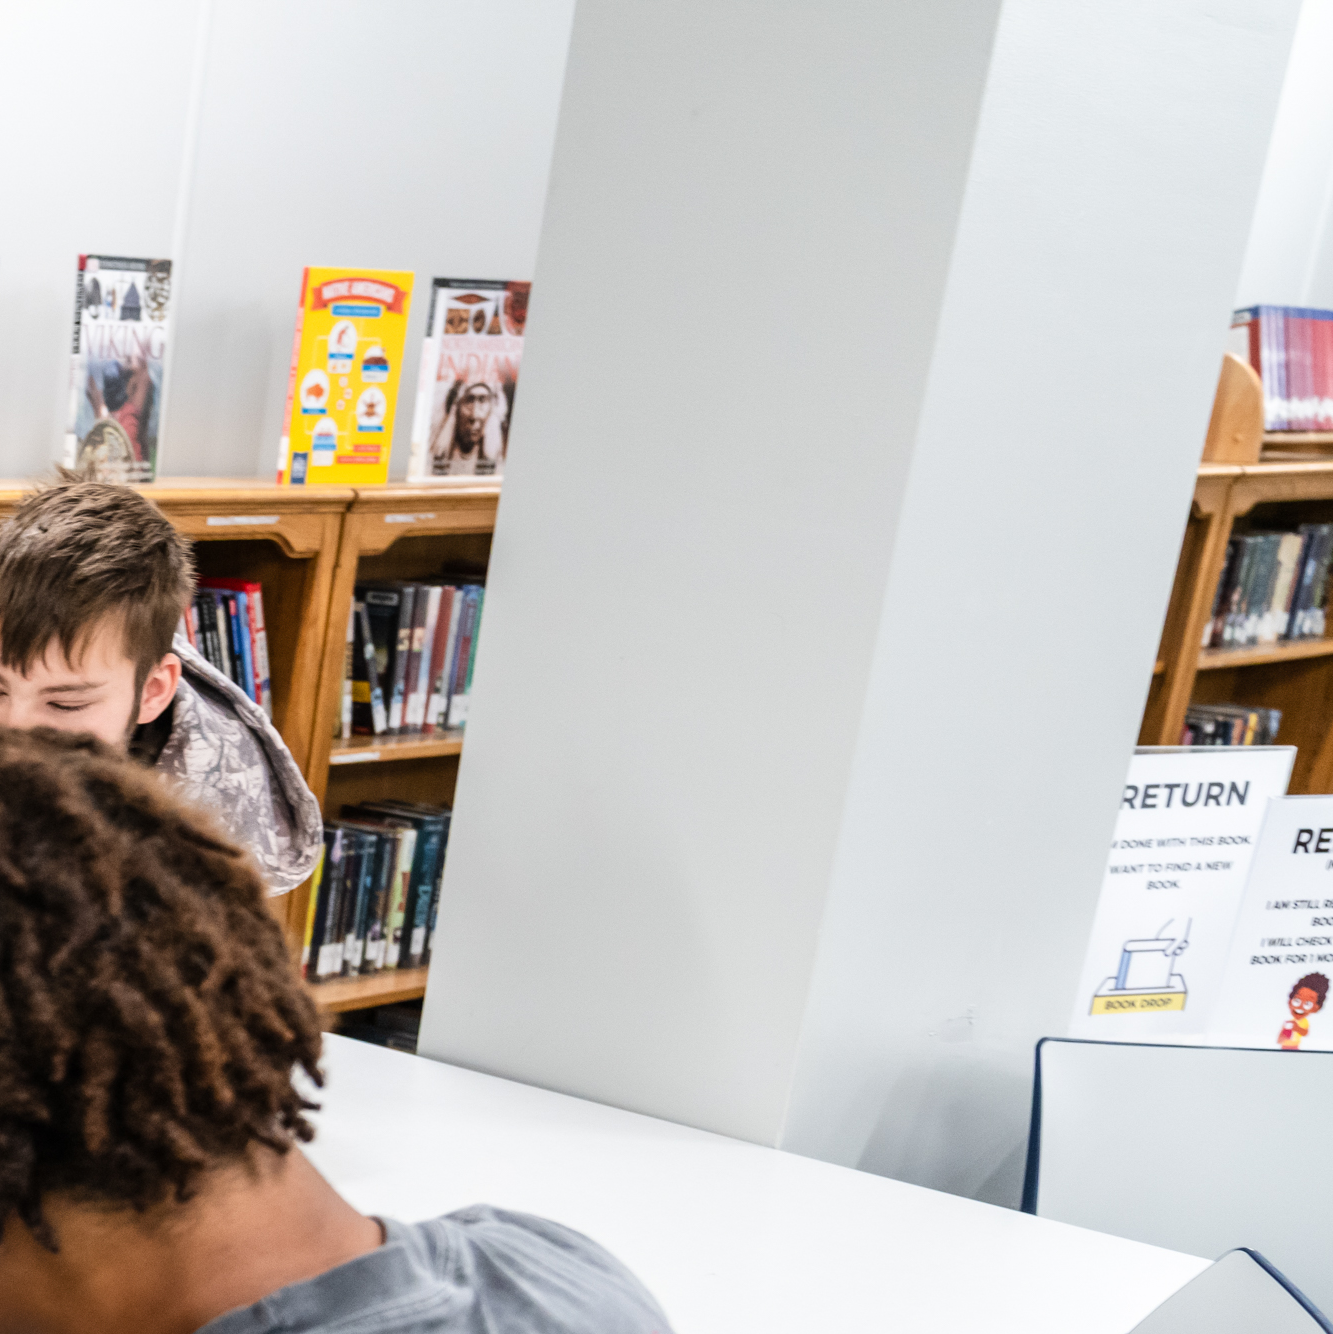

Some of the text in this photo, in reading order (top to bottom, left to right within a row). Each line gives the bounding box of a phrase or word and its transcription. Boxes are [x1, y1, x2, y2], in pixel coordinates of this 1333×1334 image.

[83, 324, 166, 361] VIKING
[1121, 781, 1250, 809] RETURN
[1120, 836, 1252, 849] DONE WITH THIS BOOK.
[1109, 864, 1144, 875] WANT
[1147, 864, 1163, 873] TO
[1166, 862, 1192, 873] FIND
[1205, 861, 1234, 872] NEW
[1146, 880, 1180, 890] BOOK.
[1292, 900, 1321, 910] STILL
[1267, 937, 1292, 948] WILL
[1250, 955, 1282, 965] BOOK
[1284, 954, 1307, 965] FOR
[1104, 997, 1173, 1010] BOOK DROP
